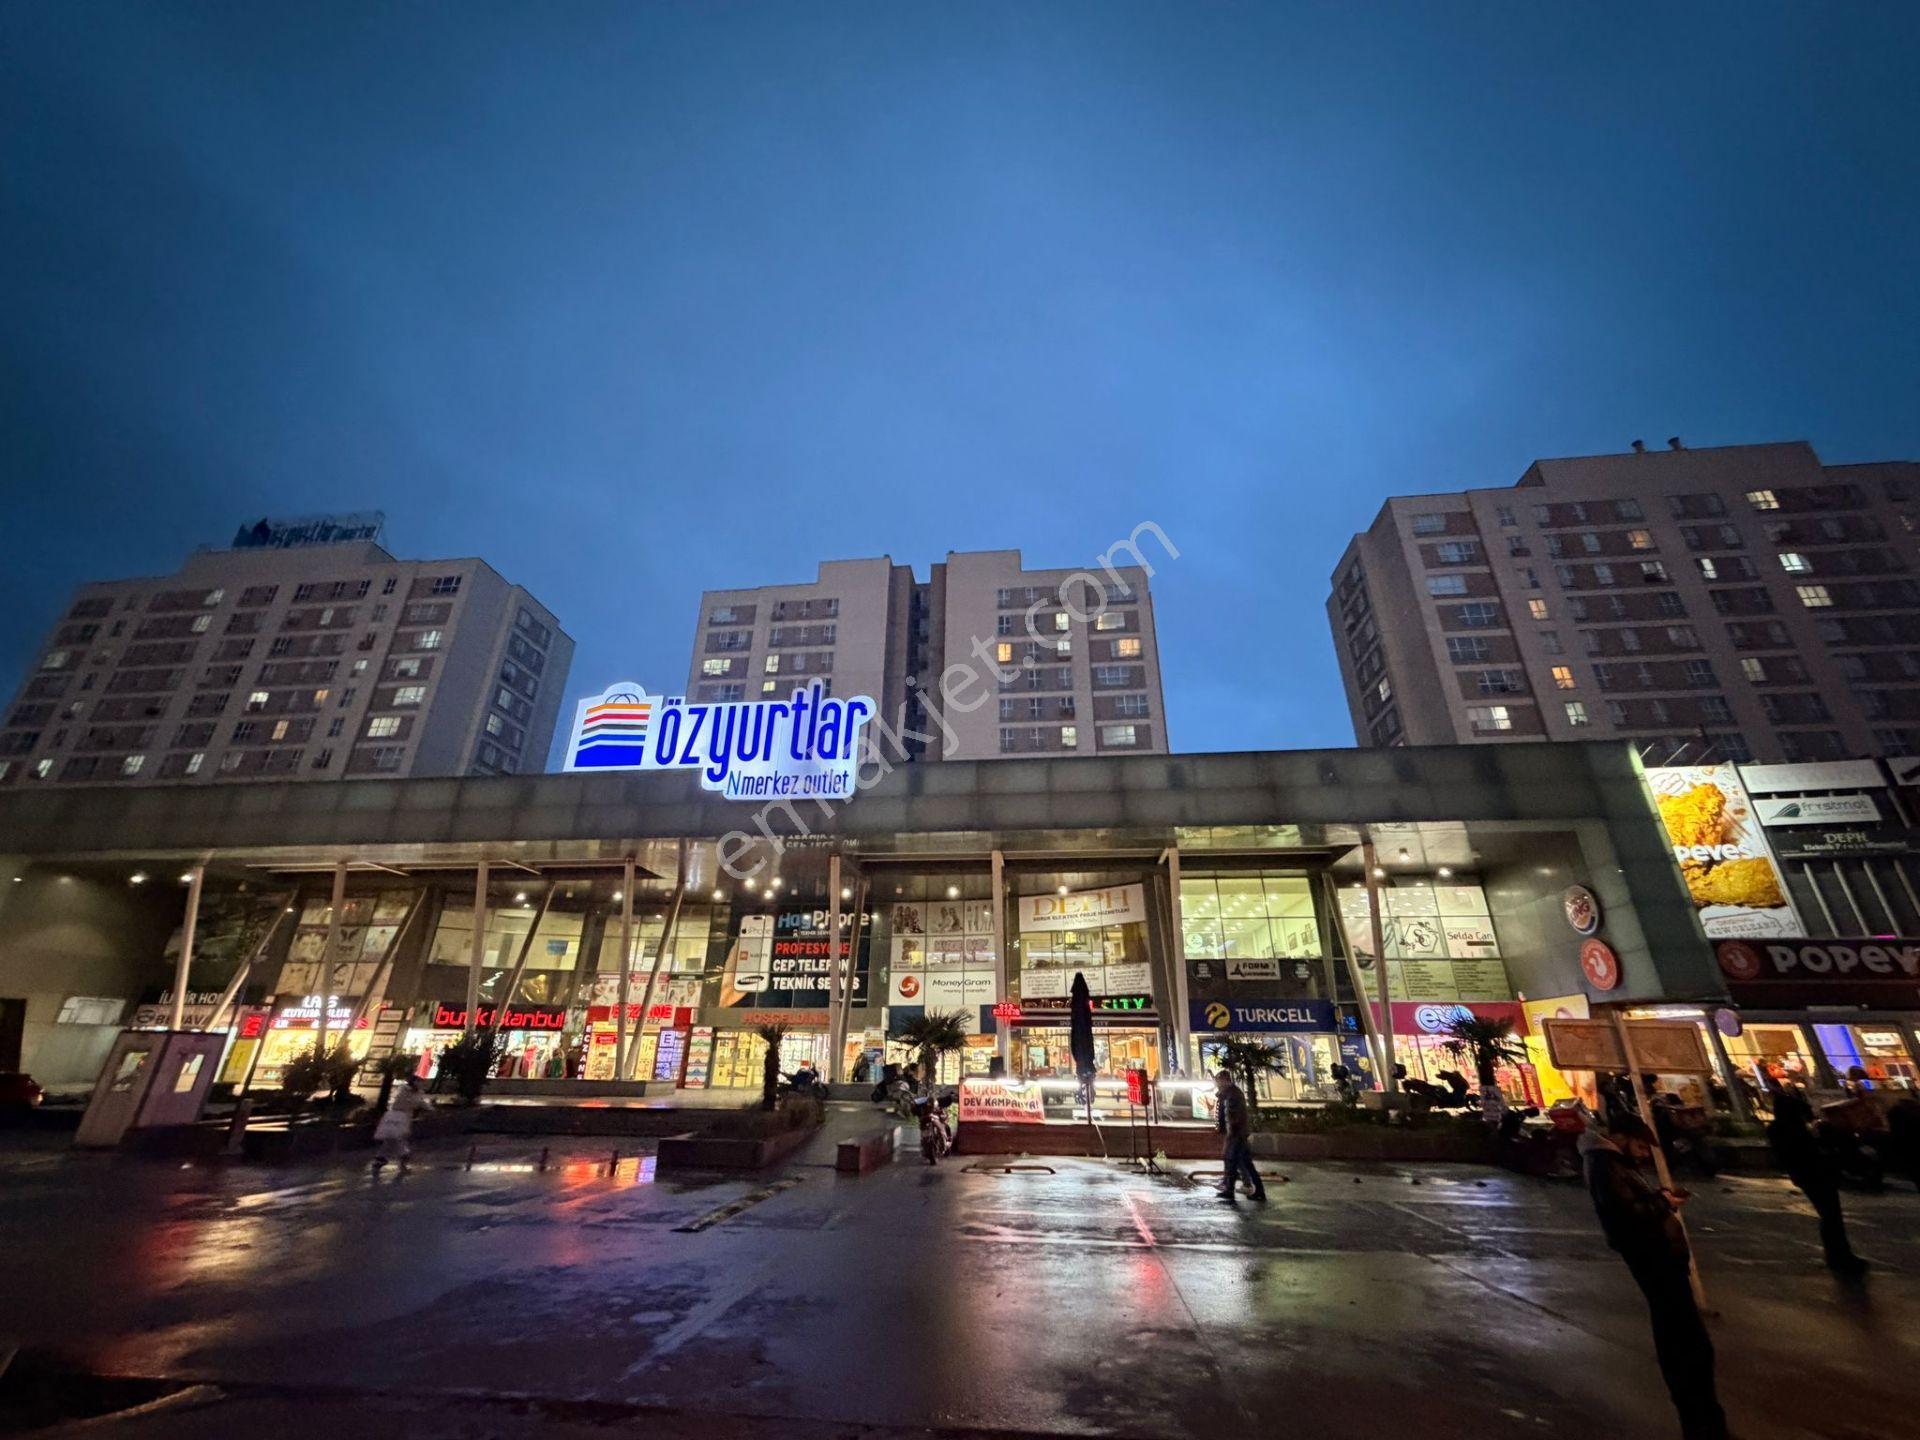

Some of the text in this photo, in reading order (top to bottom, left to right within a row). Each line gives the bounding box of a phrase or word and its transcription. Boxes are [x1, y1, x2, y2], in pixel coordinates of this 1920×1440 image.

[655, 684, 868, 783] özyurtlar
[803, 768, 850, 795] outlet
[1447, 931, 1473, 940] Selda
[773, 959, 795, 972] CEP
[773, 974, 815, 990] TEKNİK
[1101, 997, 1145, 1010] CITY
[1235, 1007, 1317, 1023] TURKCELL
[964, 1097, 982, 1107] DEV
